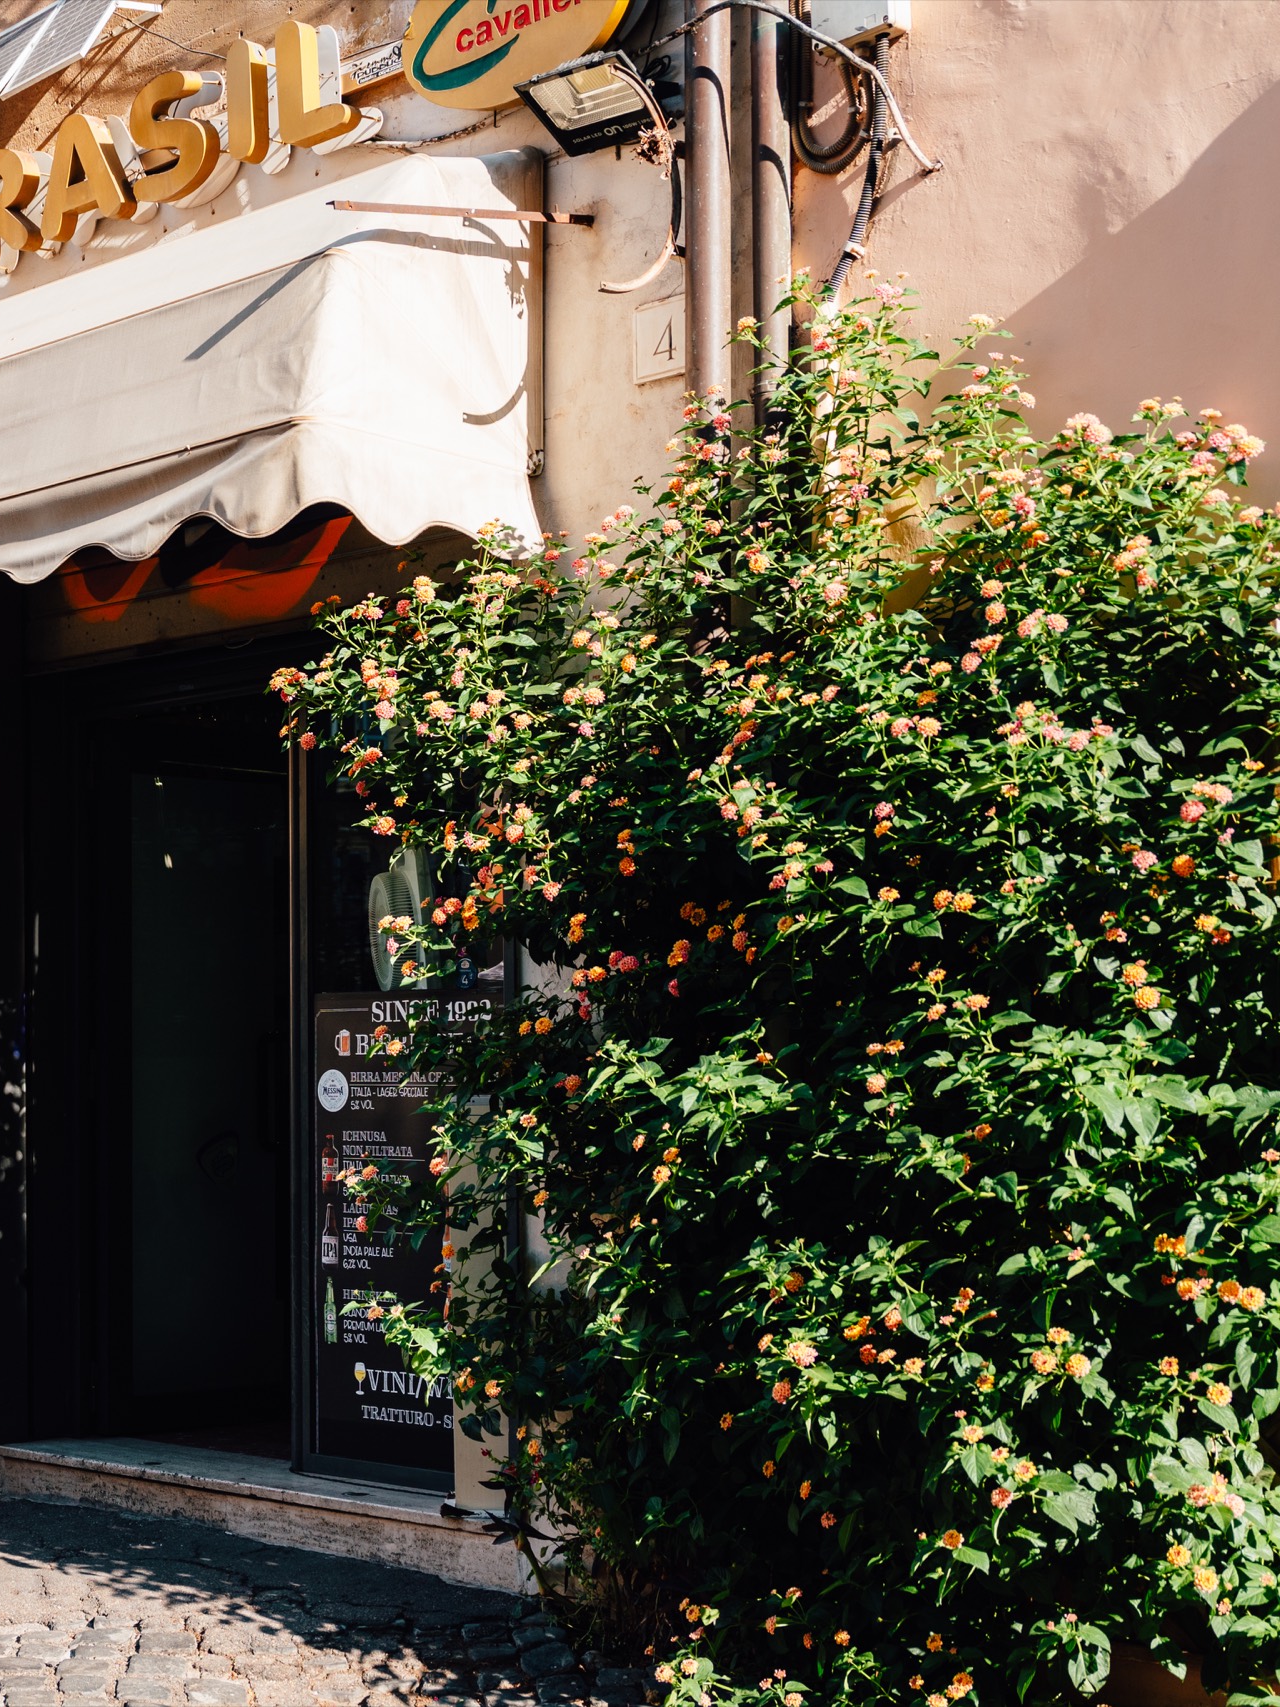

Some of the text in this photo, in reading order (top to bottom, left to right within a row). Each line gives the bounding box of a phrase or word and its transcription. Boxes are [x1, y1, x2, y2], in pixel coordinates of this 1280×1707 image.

[572, 134, 591, 144] SOLAR
[653, 315, 677, 361] 4
[350, 1072, 382, 1082] BIRRA
[383, 1072, 426, 1083] MESINA
[350, 1087, 372, 1098] ITALIA
[376, 1087, 398, 1098] LAGER
[398, 1087, 428, 1098] SPECIALE
[350, 1100, 374, 1110] 5% VOL
[342, 1130, 386, 1142] ICHNUSA
[342, 1145, 413, 1157] NON FILTRATA
[342, 1232, 358, 1242] USA
[323, 1242, 338, 1258] IPA
[343, 1245, 394, 1258] INDIA PALE ALE
[356, 1260, 371, 1270] VOL
[344, 1320, 374, 1332] PREMIUM
[344, 1333, 368, 1344] 5% VOL
[362, 1404, 434, 1427] TRATTURO
